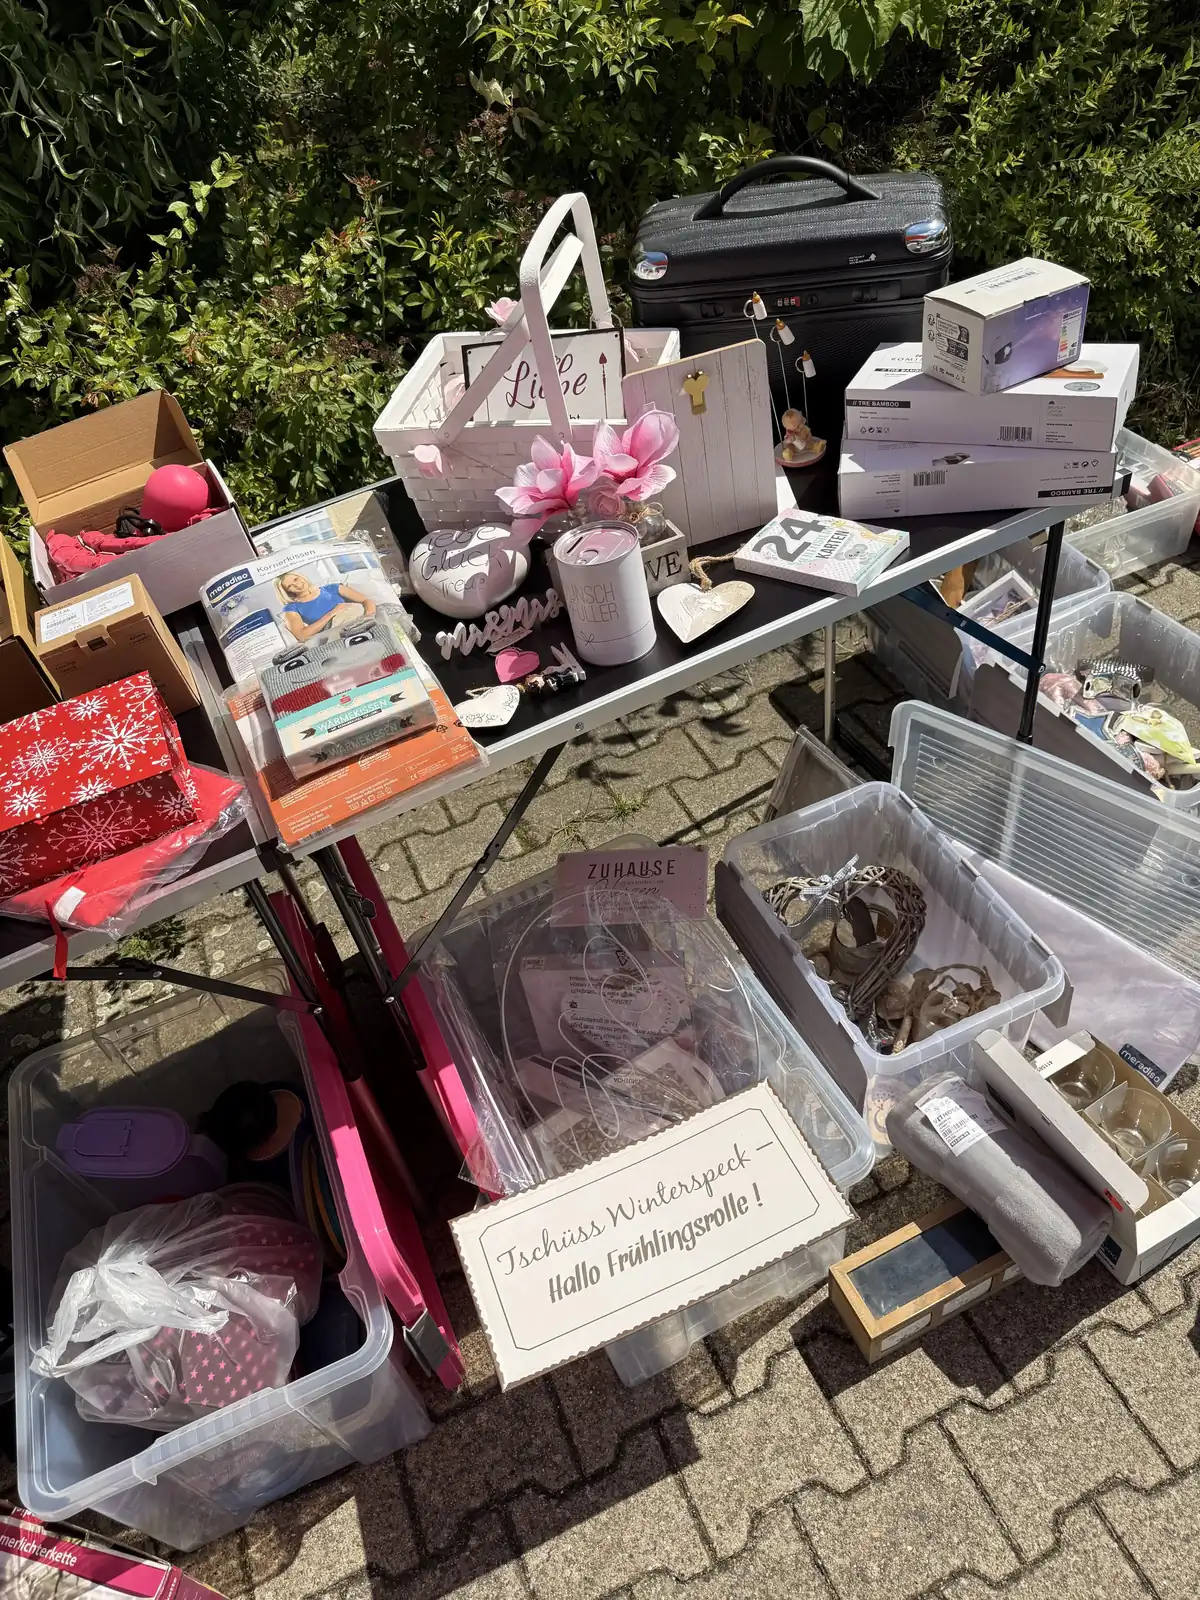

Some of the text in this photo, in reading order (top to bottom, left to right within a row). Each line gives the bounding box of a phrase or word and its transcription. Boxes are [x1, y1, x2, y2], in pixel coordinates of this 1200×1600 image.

[1050, 489, 1081, 497] BAMBOO
[752, 517, 826, 563] 24
[815, 529, 850, 560] KARTEN
[645, 550, 683, 583] VE
[208, 571, 249, 599] meradiso
[587, 859, 676, 880] ZUHAUSE
[1120, 1049, 1160, 1084] meradiso
[496, 1220, 606, 1276] Tschüss
[606, 1142, 751, 1228] Winterspeck
[548, 1261, 601, 1304] Hallo
[606, 1191, 750, 1278] Frühlingsrolle
